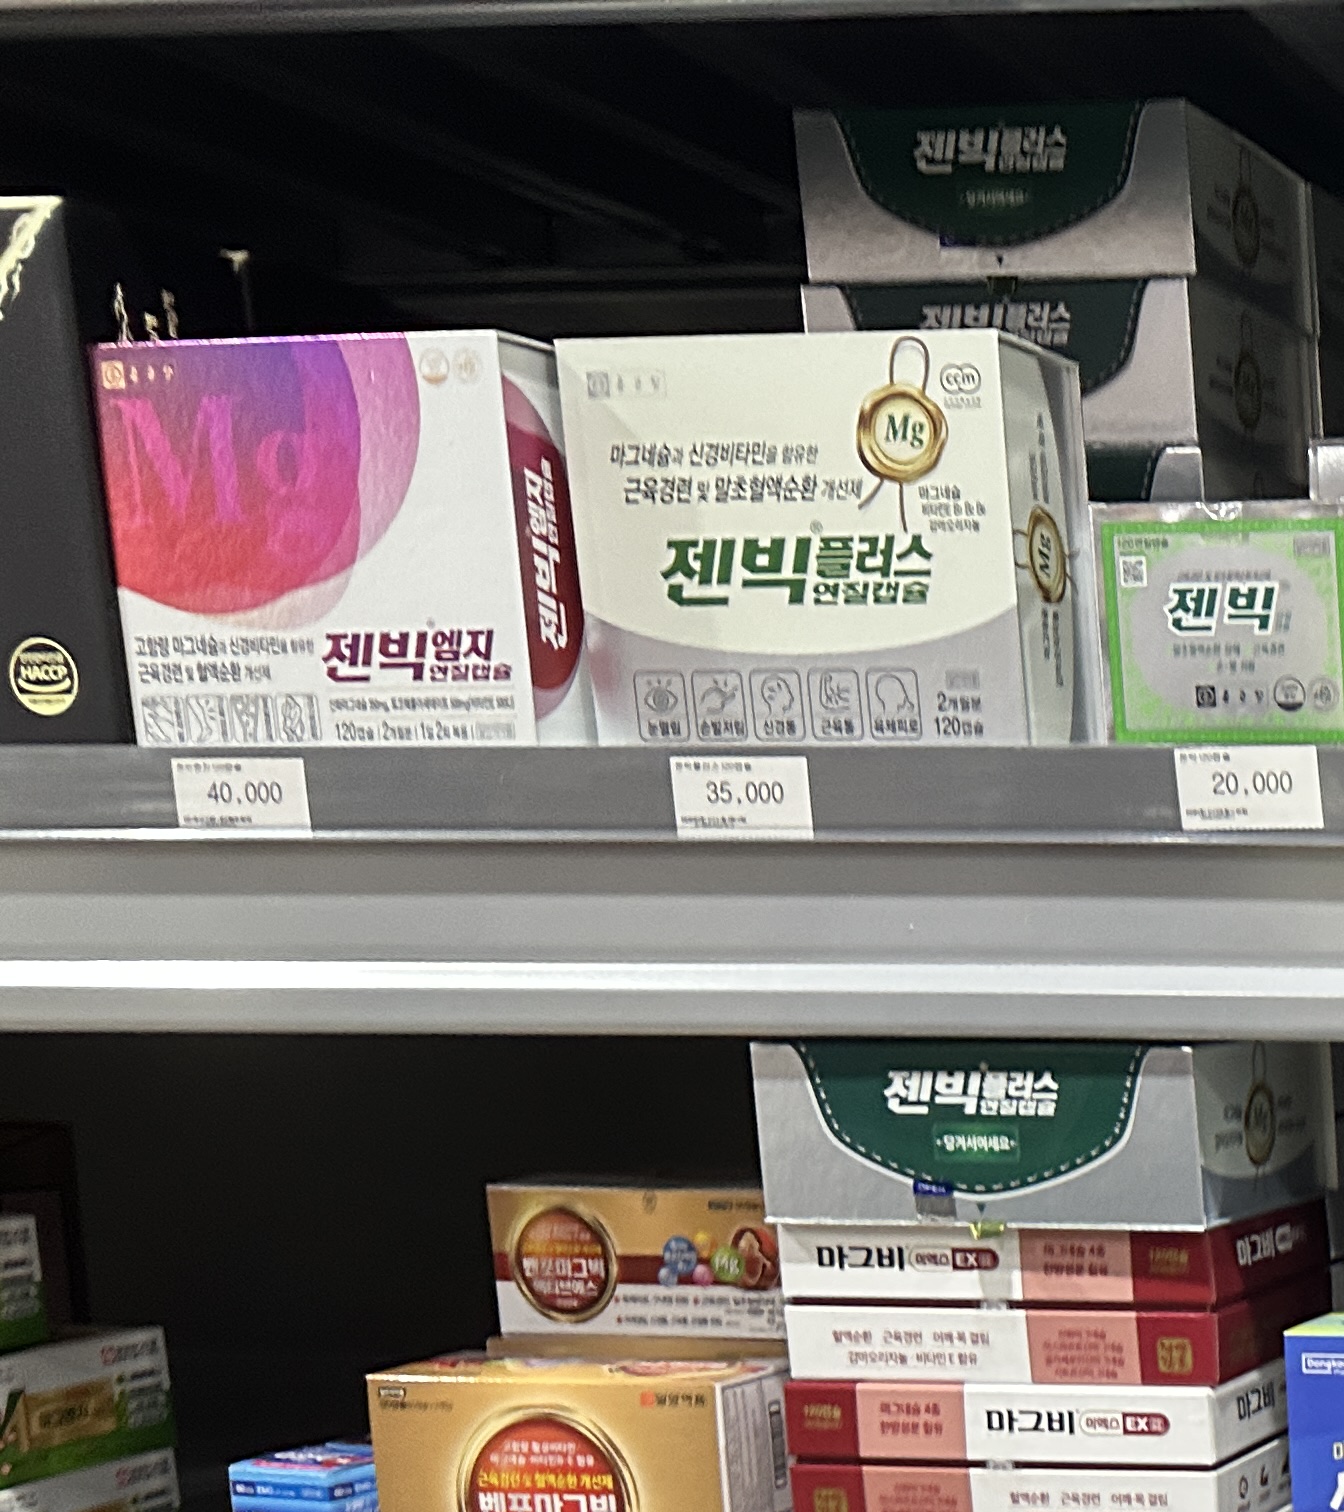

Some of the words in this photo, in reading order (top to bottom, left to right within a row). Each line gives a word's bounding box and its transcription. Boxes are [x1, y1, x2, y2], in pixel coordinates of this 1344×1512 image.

[884, 414, 926, 447] Mg
[660, 536, 810, 608] 젠빅
[814, 532, 934, 578] 플러스
[811, 580, 931, 606] 연질캡슐
[1165, 581, 1279, 635] 젠빅
[322, 629, 429, 682] 젠빅
[430, 626, 496, 662] 엠지
[20, 665, 69, 682] HACCP
[206, 781, 284, 806] 40,000
[705, 780, 785, 806] 35,000
[1211, 770, 1294, 796] 20,000
[884, 1070, 980, 1117] 젠빅
[815, 1244, 906, 1271] 마그비
[985, 1408, 1076, 1436] 마그비
